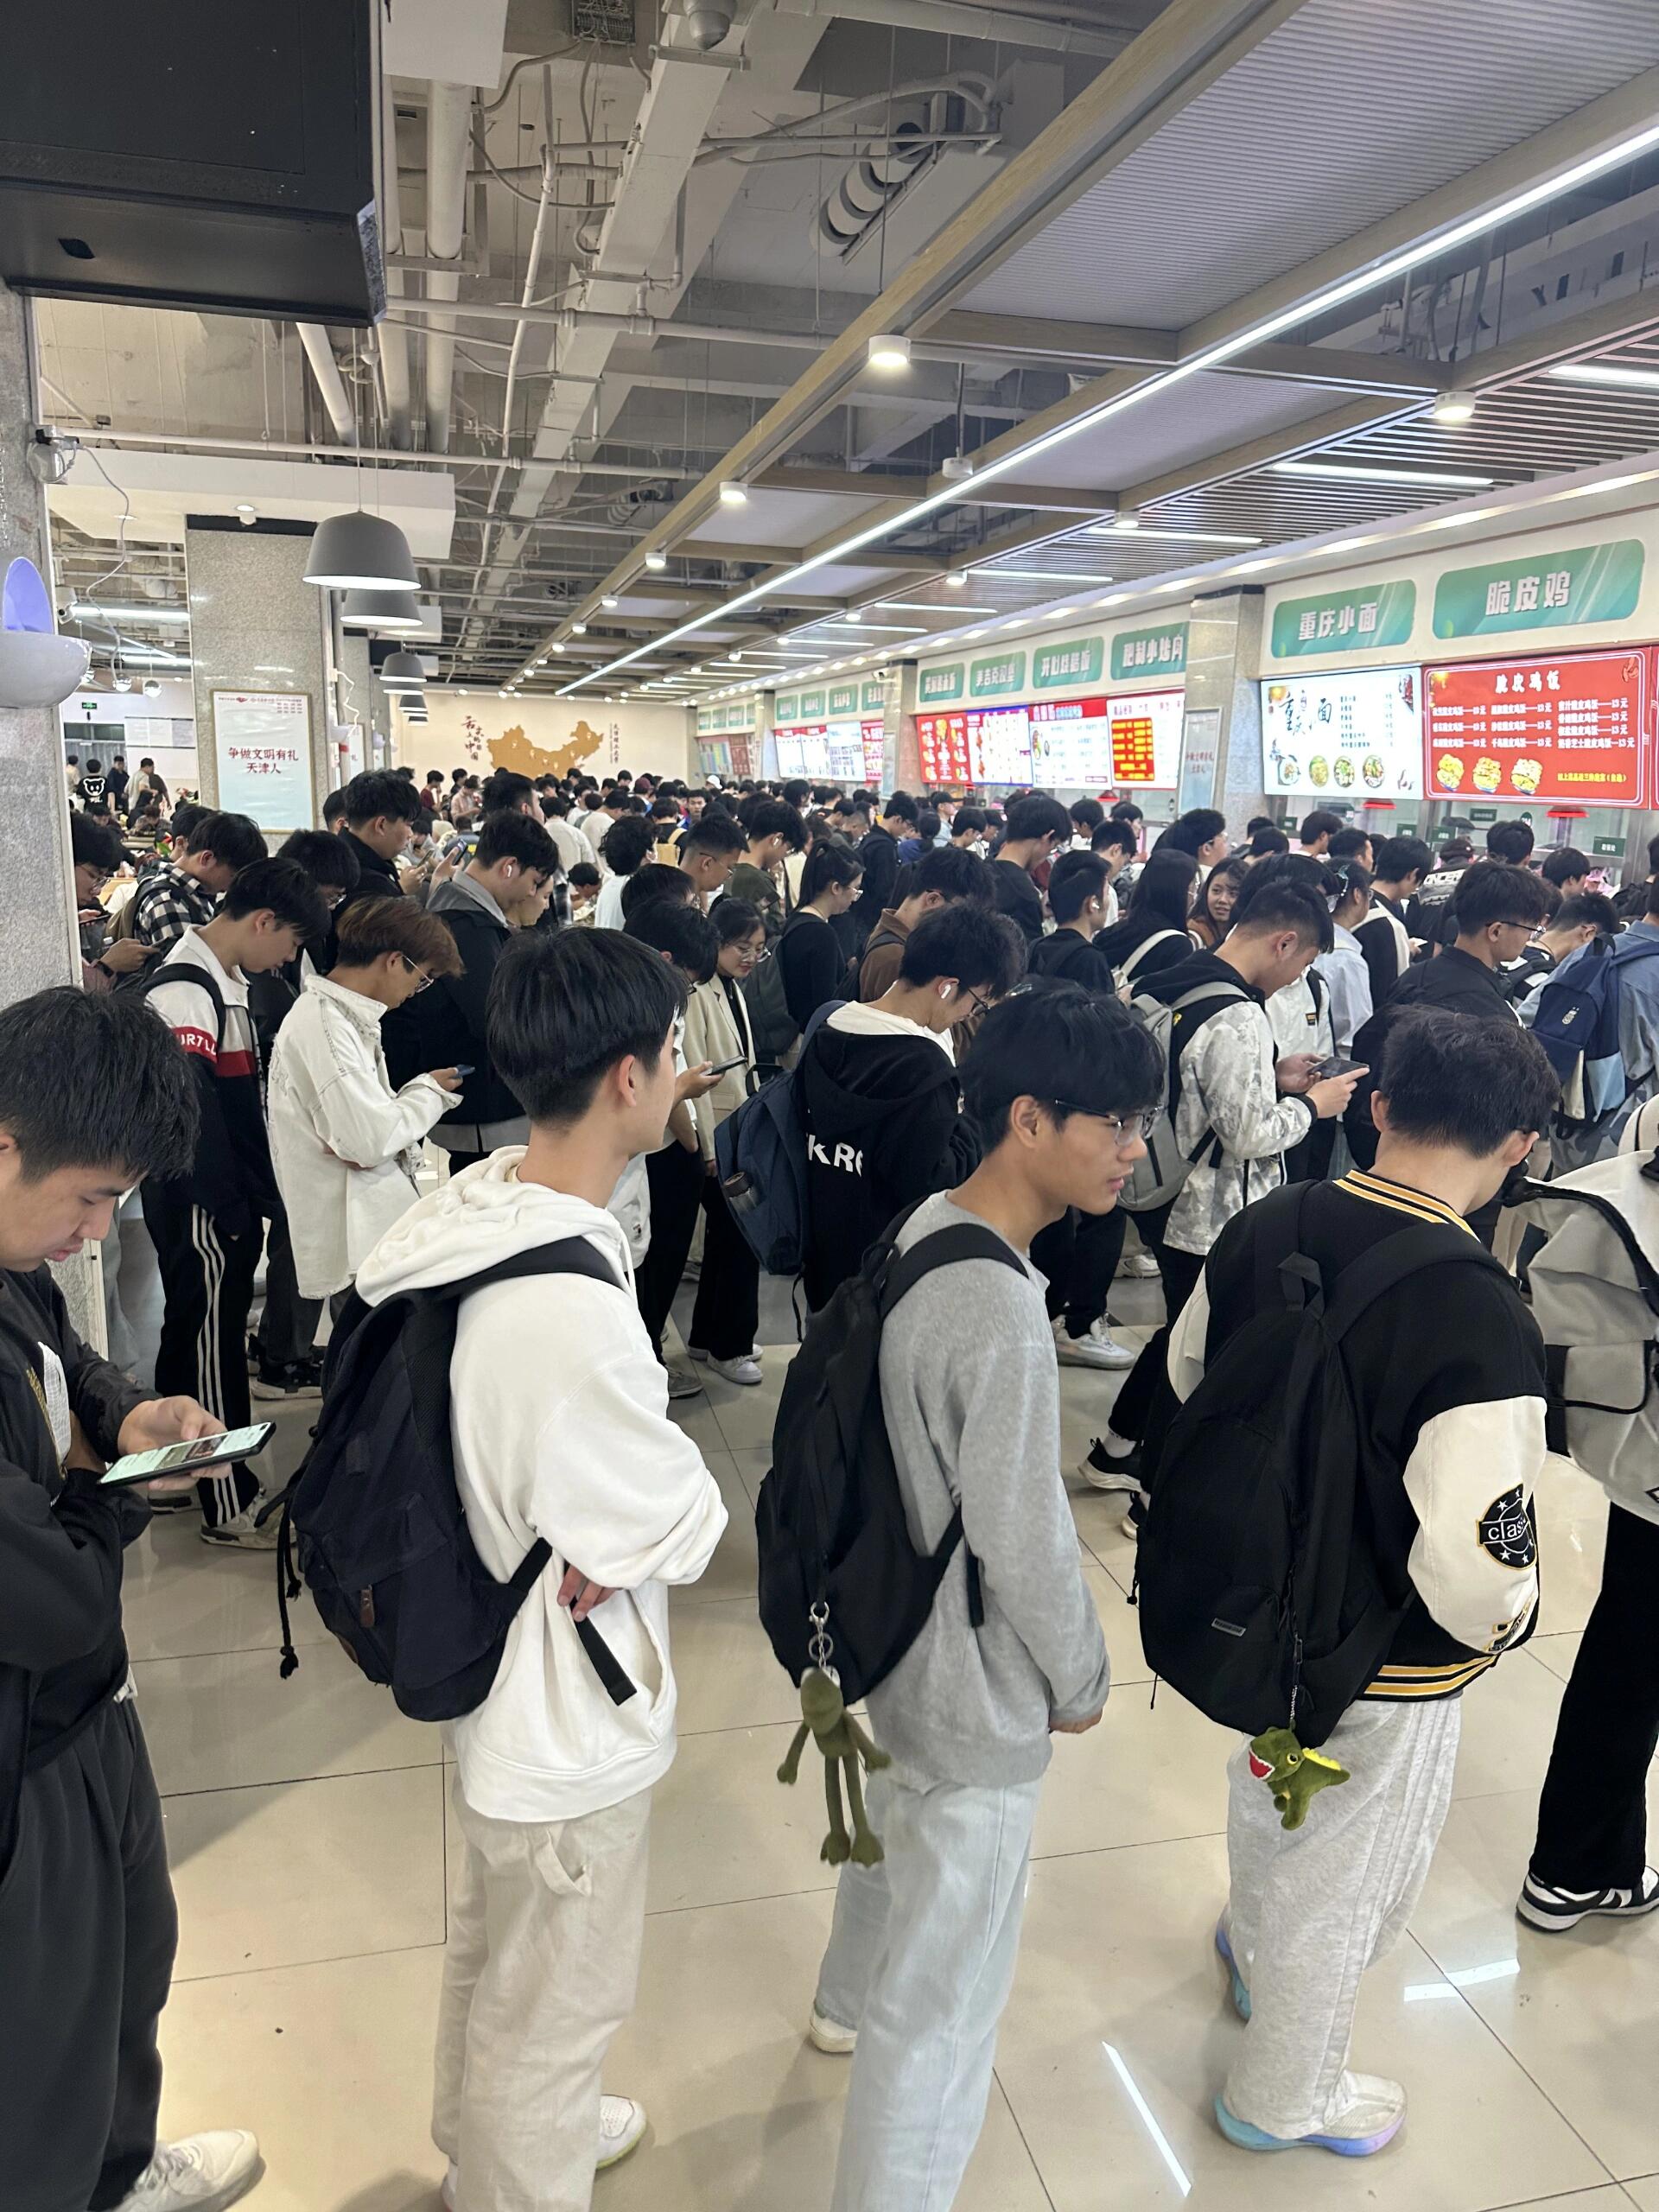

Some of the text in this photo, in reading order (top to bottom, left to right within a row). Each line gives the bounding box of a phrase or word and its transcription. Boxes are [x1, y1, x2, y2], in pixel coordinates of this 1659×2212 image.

[1485, 571, 1571, 615] 脆皮鸡
[1298, 602, 1377, 641] 重庆小面
[228, 747, 299, 761] 争做文明有礼
[246, 762, 282, 774] 天津人
